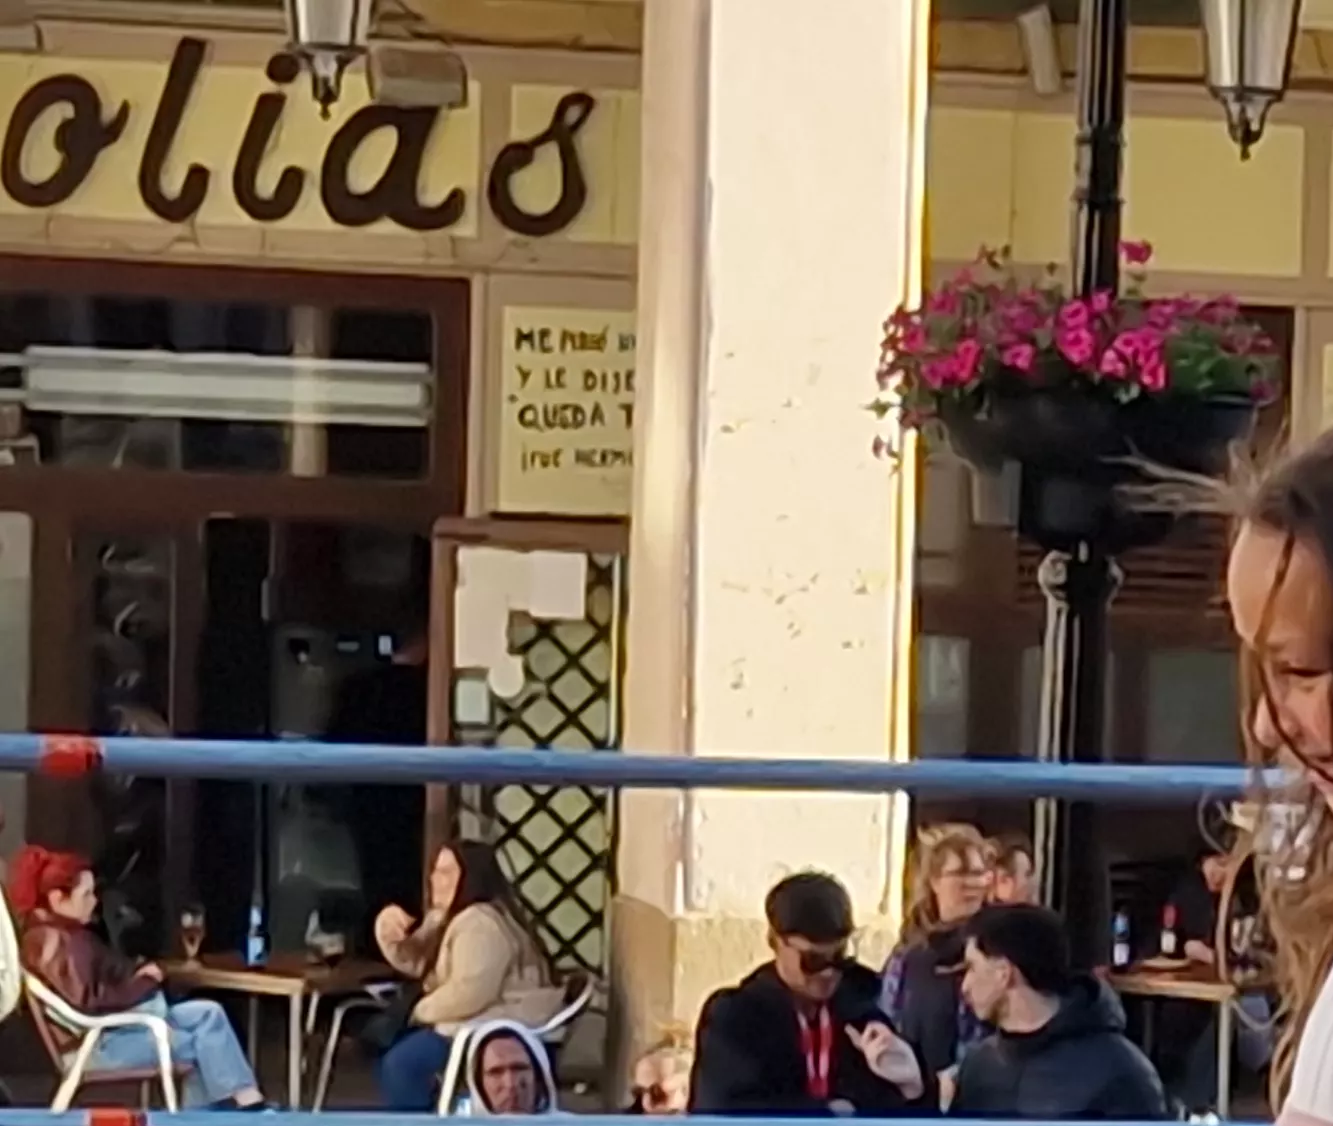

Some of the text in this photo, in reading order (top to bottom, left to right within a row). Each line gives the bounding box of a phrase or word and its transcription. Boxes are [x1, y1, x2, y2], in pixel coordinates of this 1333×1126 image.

[515, 327, 553, 353] ME
[515, 364, 532, 388] Y
[544, 367, 567, 390] LE
